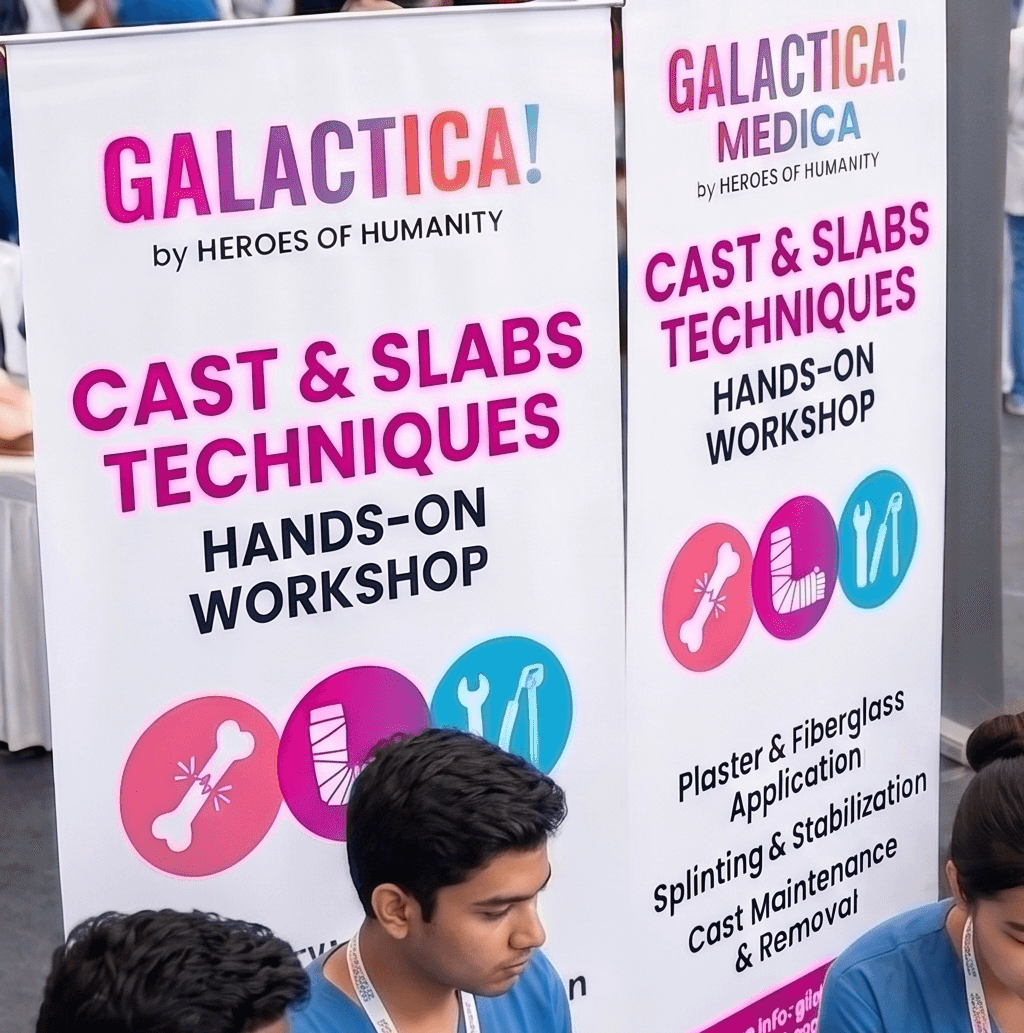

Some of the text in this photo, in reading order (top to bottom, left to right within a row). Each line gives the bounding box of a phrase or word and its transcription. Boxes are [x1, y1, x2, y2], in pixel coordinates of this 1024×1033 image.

[669, 20, 907, 112] GALACTICA!
[104, 104, 541, 223] GALACTICA!
[718, 101, 861, 162] MEDICA
[697, 152, 879, 202] by HEROES OF HUMANITY
[153, 210, 503, 272] by HEROES OF HUMANITY
[645, 201, 929, 302] CAST & SLABS
[661, 266, 916, 368] TECHNIQUES
[73, 311, 583, 431] CAST & SLABS
[713, 341, 874, 415] HANDS-ON
[104, 393, 560, 513] TECHNIQUES
[706, 389, 875, 465] WORKSHOP
[203, 487, 486, 572] HANDS-ON
[189, 546, 488, 634] WORKSHOP
[678, 690, 905, 802] Plaster & Fiberglass
[730, 747, 861, 824] Application
[654, 770, 927, 916] Splinting & Stabilization
[688, 837, 898, 953] Cast Maintenance
[735, 889, 859, 973] & Removal
